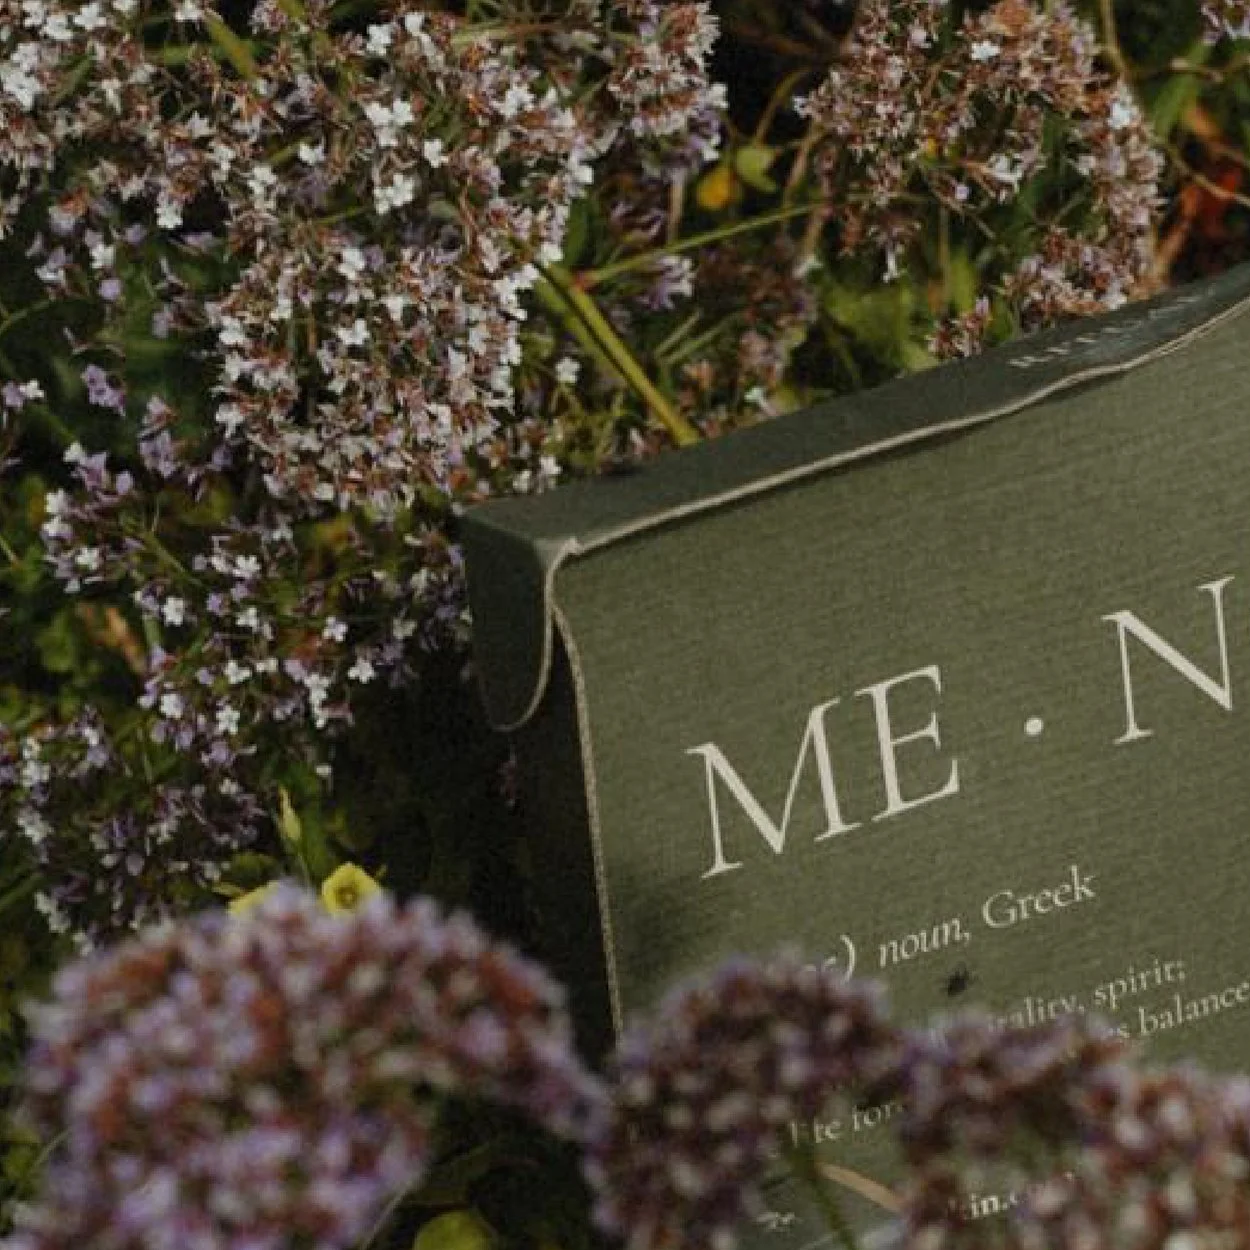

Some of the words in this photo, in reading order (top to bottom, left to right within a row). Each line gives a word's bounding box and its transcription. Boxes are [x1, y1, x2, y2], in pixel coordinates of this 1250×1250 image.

[684, 664, 960, 879] ME
[879, 917, 972, 968] noun,
[982, 864, 1097, 929] Greek
